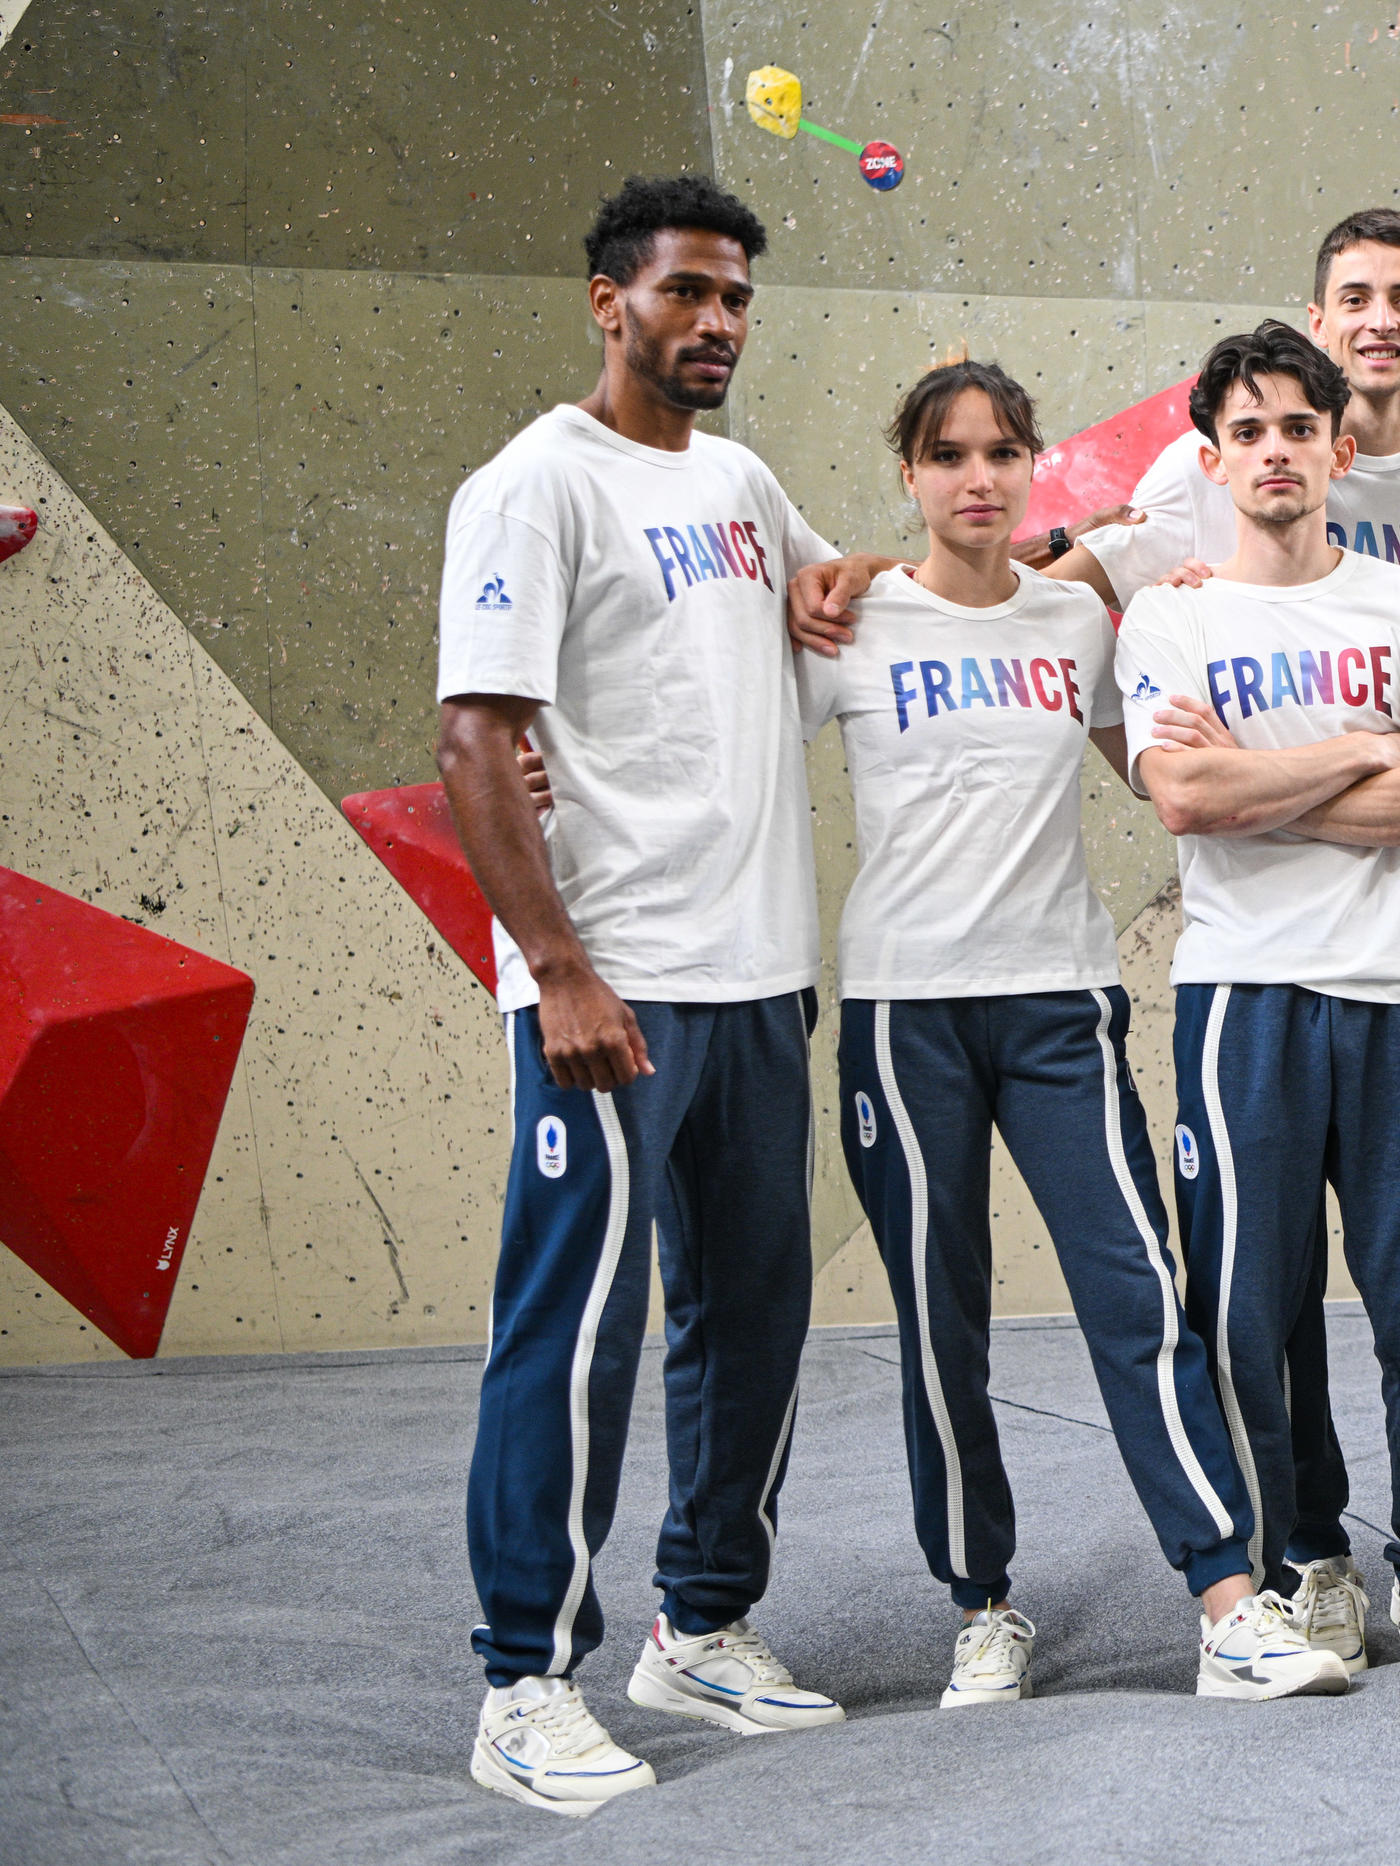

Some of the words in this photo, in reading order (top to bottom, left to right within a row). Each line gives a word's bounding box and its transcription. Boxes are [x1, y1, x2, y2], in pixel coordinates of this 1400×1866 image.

[865, 155, 897, 170] ZONE
[643, 520, 775, 602] FRANCE
[889, 657, 1084, 735] FRANCE
[1207, 646, 1392, 730] FRANCE
[160, 1226, 180, 1260] LYNX
